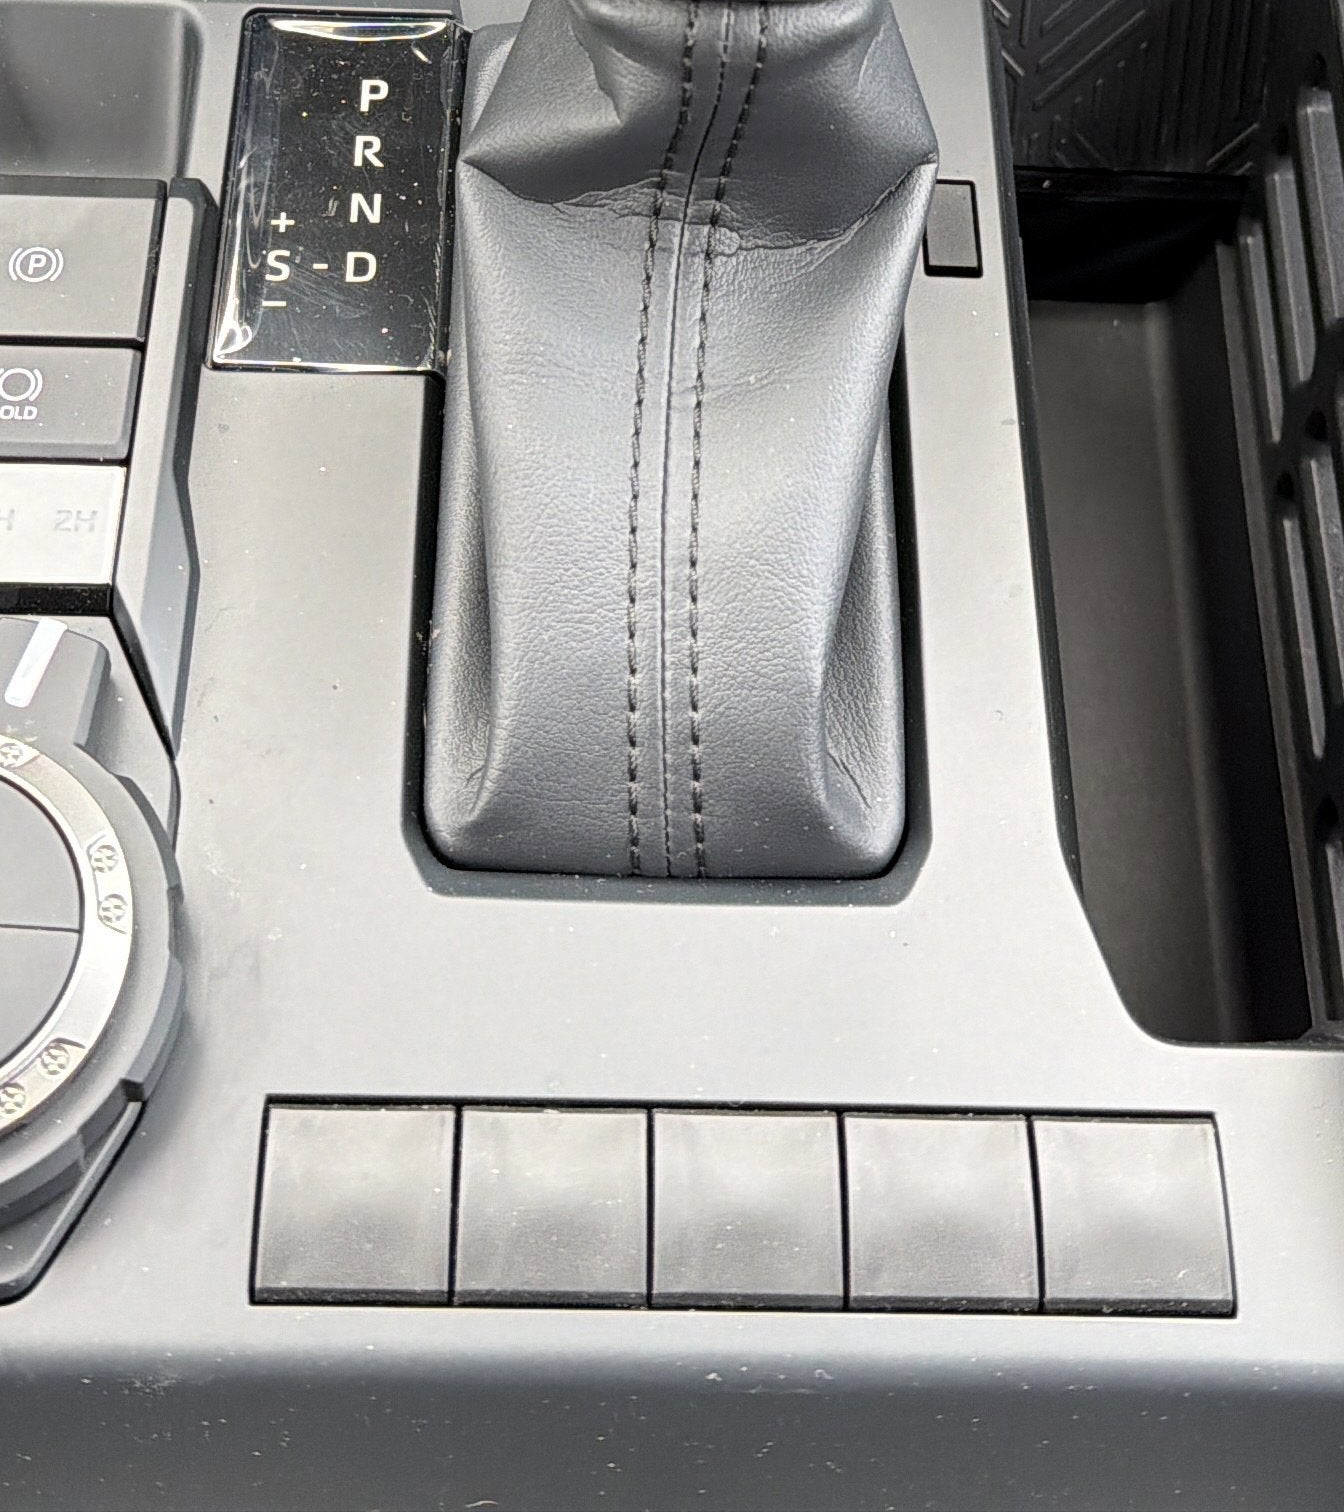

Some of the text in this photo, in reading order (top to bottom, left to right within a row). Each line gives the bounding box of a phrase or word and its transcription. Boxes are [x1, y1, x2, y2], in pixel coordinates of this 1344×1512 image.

[359, 78, 389, 113] P
[353, 135, 385, 168] R
[349, 192, 382, 224] N
[53, 509, 99, 533] 2H
